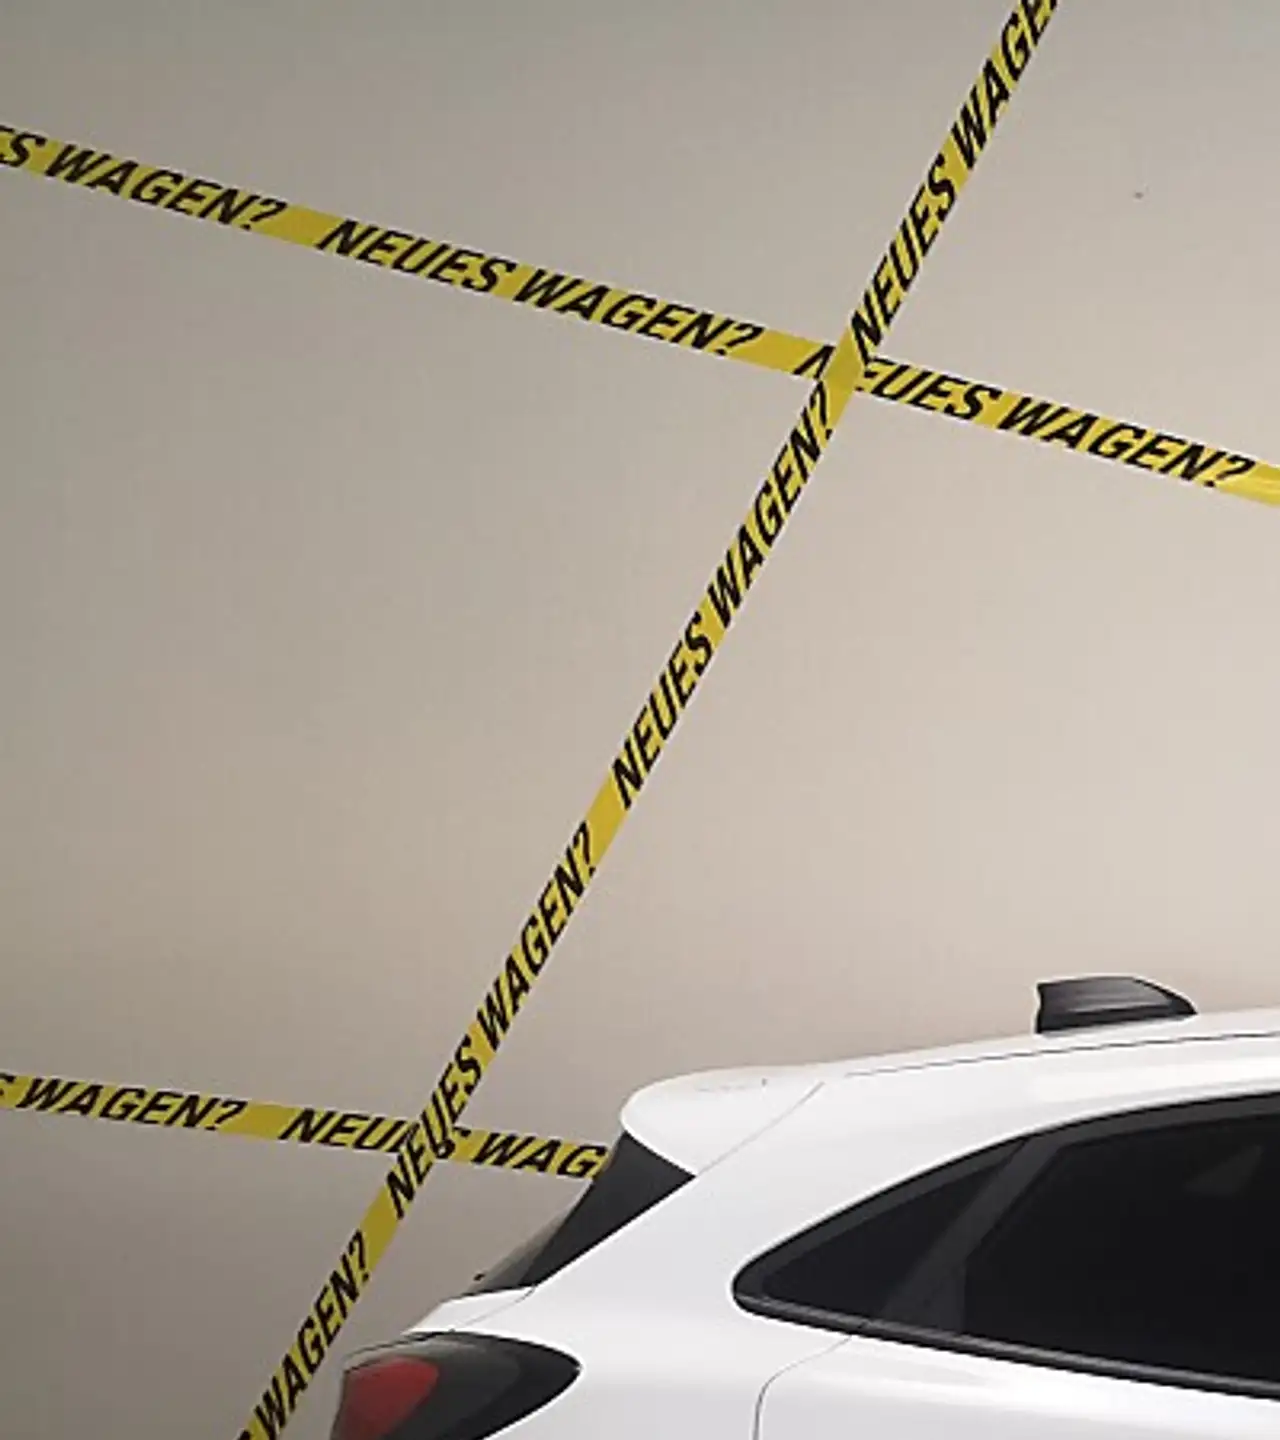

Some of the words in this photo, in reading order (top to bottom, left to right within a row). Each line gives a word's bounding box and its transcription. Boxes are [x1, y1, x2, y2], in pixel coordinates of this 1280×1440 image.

[45, 144, 287, 230] WAGEN?
[850, 155, 956, 363] NEUES
[951, 0, 1057, 168] WAGE
[316, 220, 516, 294] NEUES
[512, 268, 764, 355] WAGEN?
[998, 397, 1255, 486] WAGEN?
[612, 612, 712, 809] NEUES
[707, 381, 833, 628] WAGEN?
[386, 1036, 480, 1219] NEUES
[476, 820, 596, 1052] WAGEN?
[15, 1078, 248, 1131] WAGEN?
[472, 1133, 607, 1178] WAG
